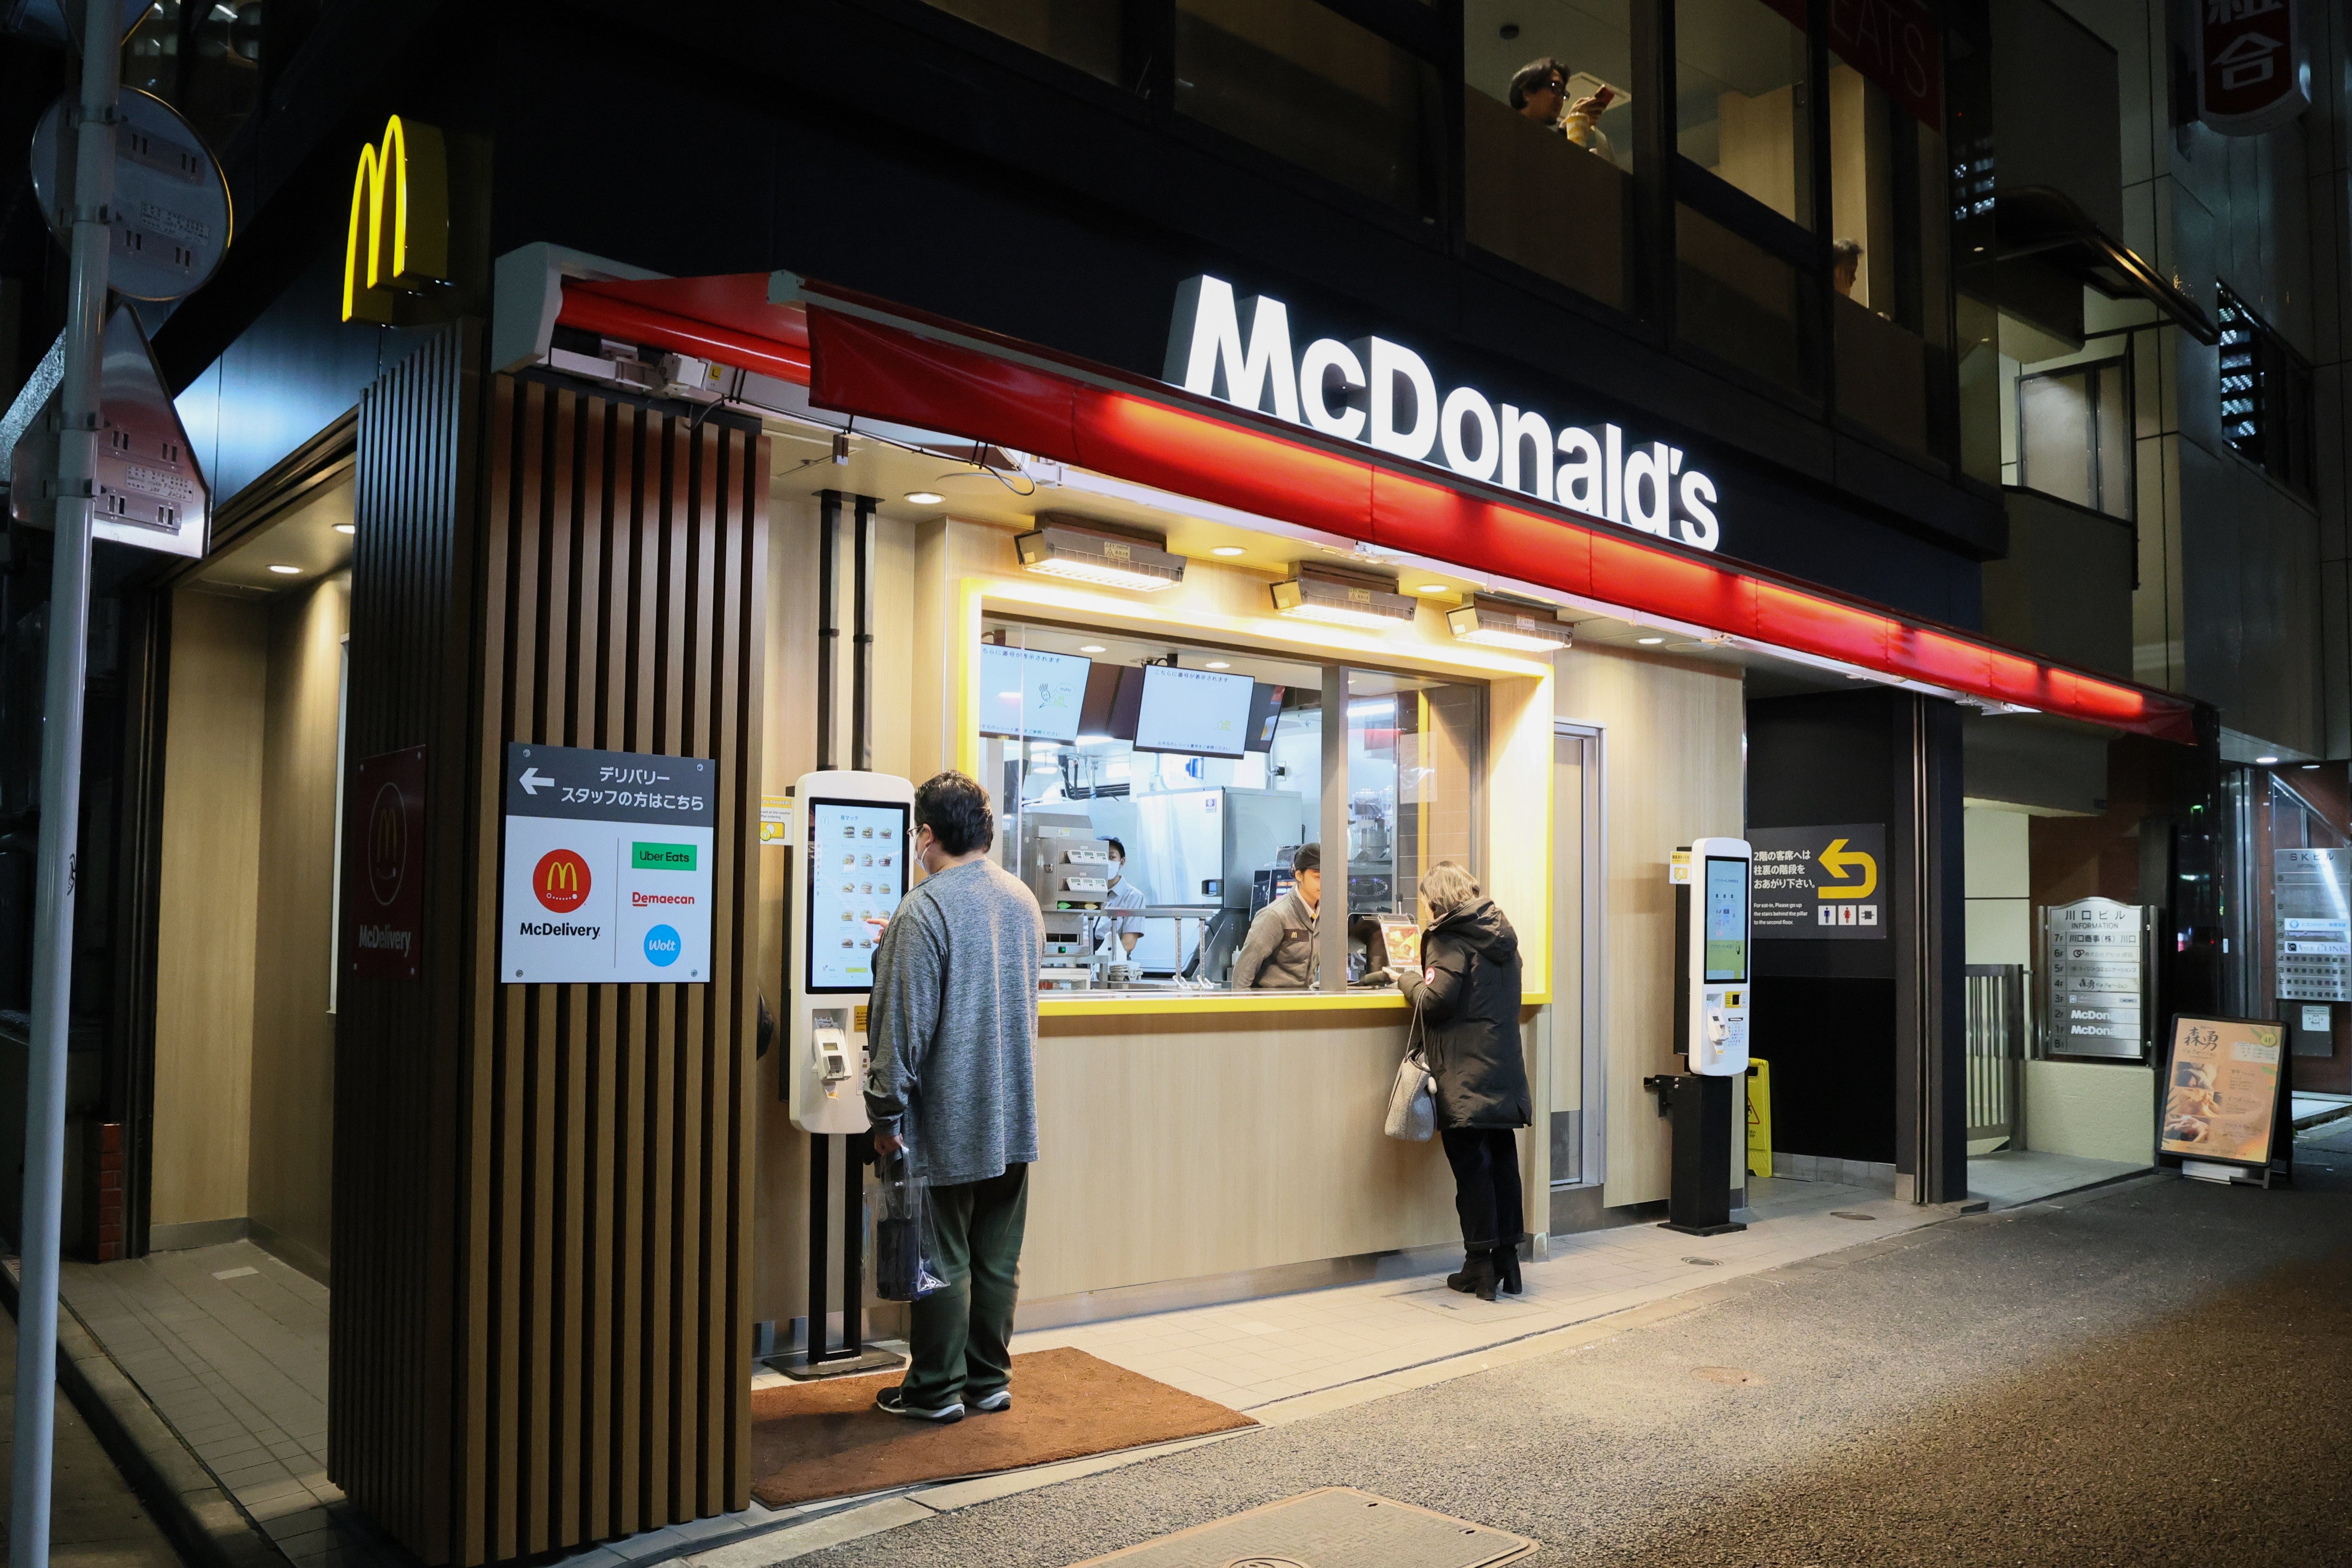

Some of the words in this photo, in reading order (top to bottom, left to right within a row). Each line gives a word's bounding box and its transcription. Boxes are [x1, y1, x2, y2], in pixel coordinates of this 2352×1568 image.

[1183, 274, 1720, 552] McDonald's
[982, 648, 1061, 663] ちらに番号が表示されます
[1155, 669, 1229, 682] こちらに番号が表示されます
[600, 766, 670, 785] デリバリー
[561, 787, 703, 811] スタッフの方はこちら
[639, 850, 664, 861] Uber
[665, 852, 690, 863] Eats
[1754, 850, 1811, 861] 2階の客席へは
[1754, 864, 1805, 875] 柱裏の階段を
[1754, 878, 1815, 889] おあがり下さい。
[632, 891, 695, 905] Demaecan
[2065, 910, 2125, 921] 川口ビル
[520, 922, 600, 940] McDelivery
[359, 925, 411, 958] McDelivery
[2054, 934, 2063, 942] 7F
[648, 939, 676, 952] Wolt
[2054, 949, 2063, 958] 6F
